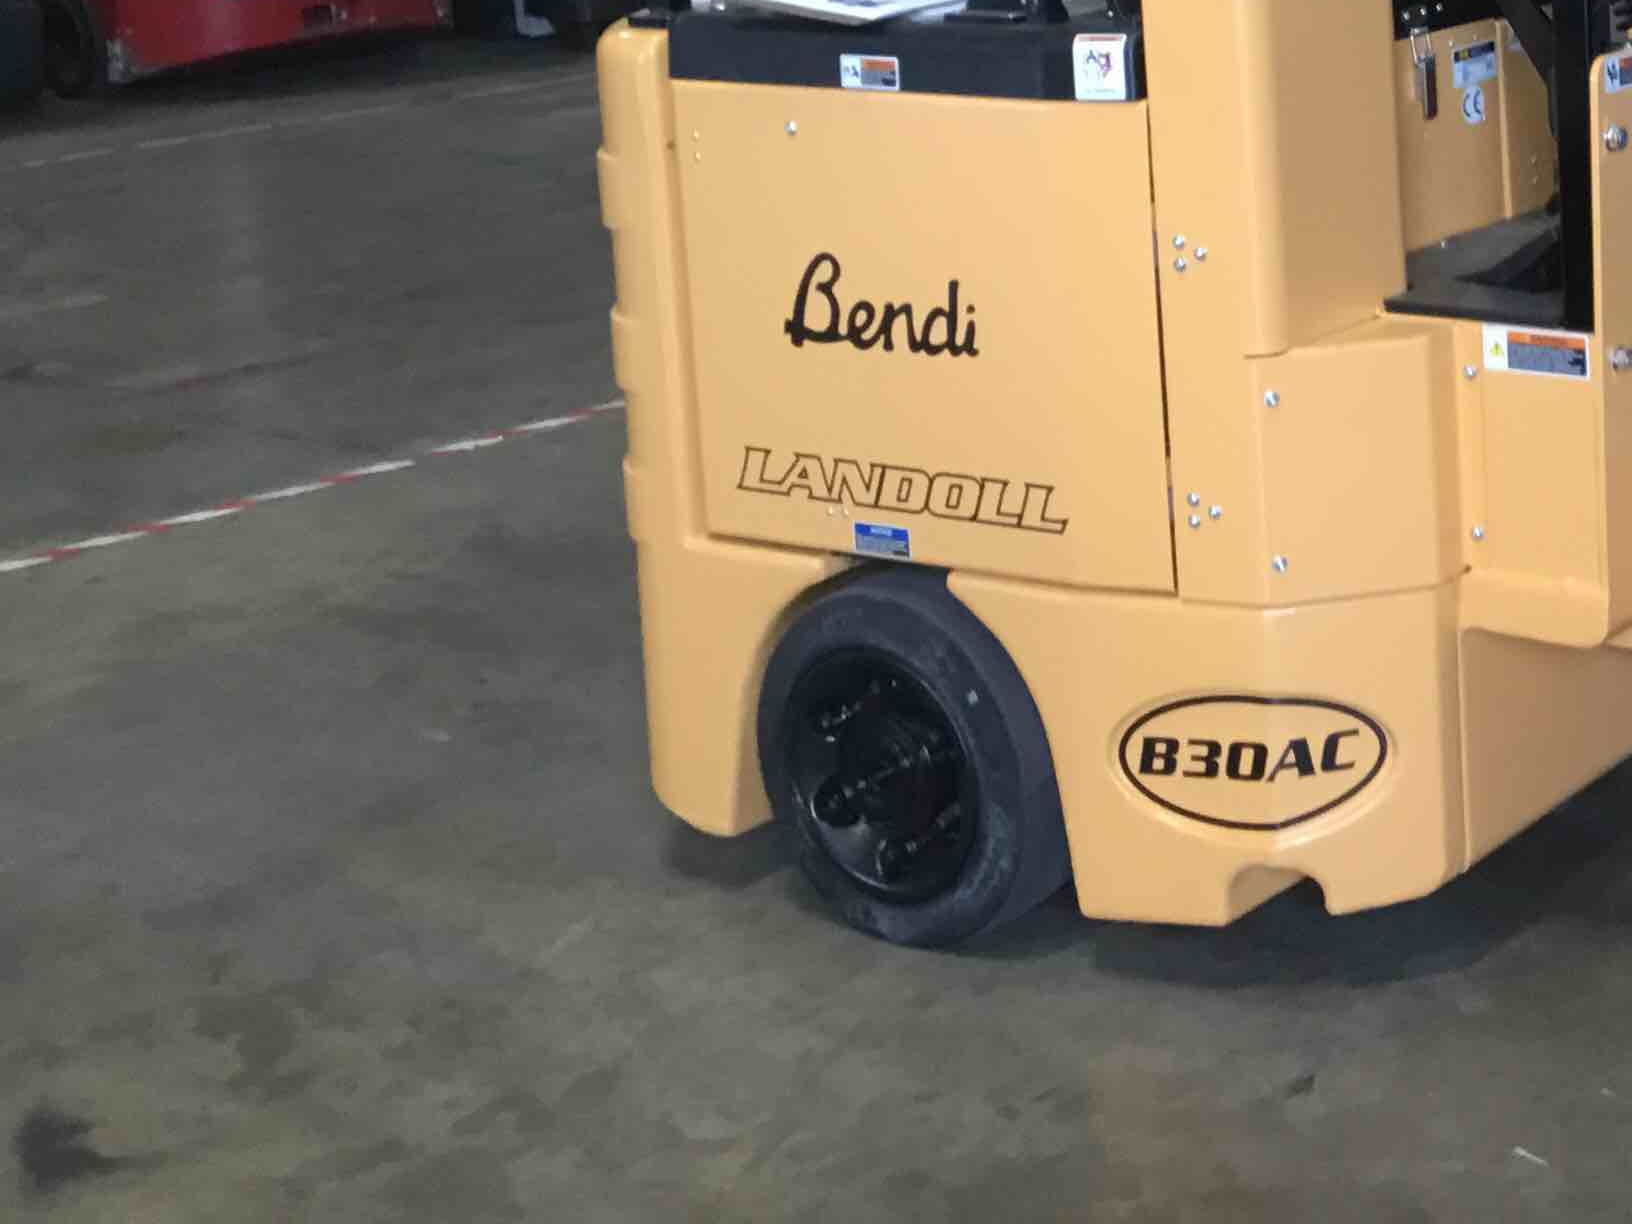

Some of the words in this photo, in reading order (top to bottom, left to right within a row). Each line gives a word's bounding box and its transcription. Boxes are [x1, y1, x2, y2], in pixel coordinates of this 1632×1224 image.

[784, 251, 980, 357] Bendi
[736, 445, 1070, 536] LANDOLL
[1138, 727, 1360, 783] B30AC
